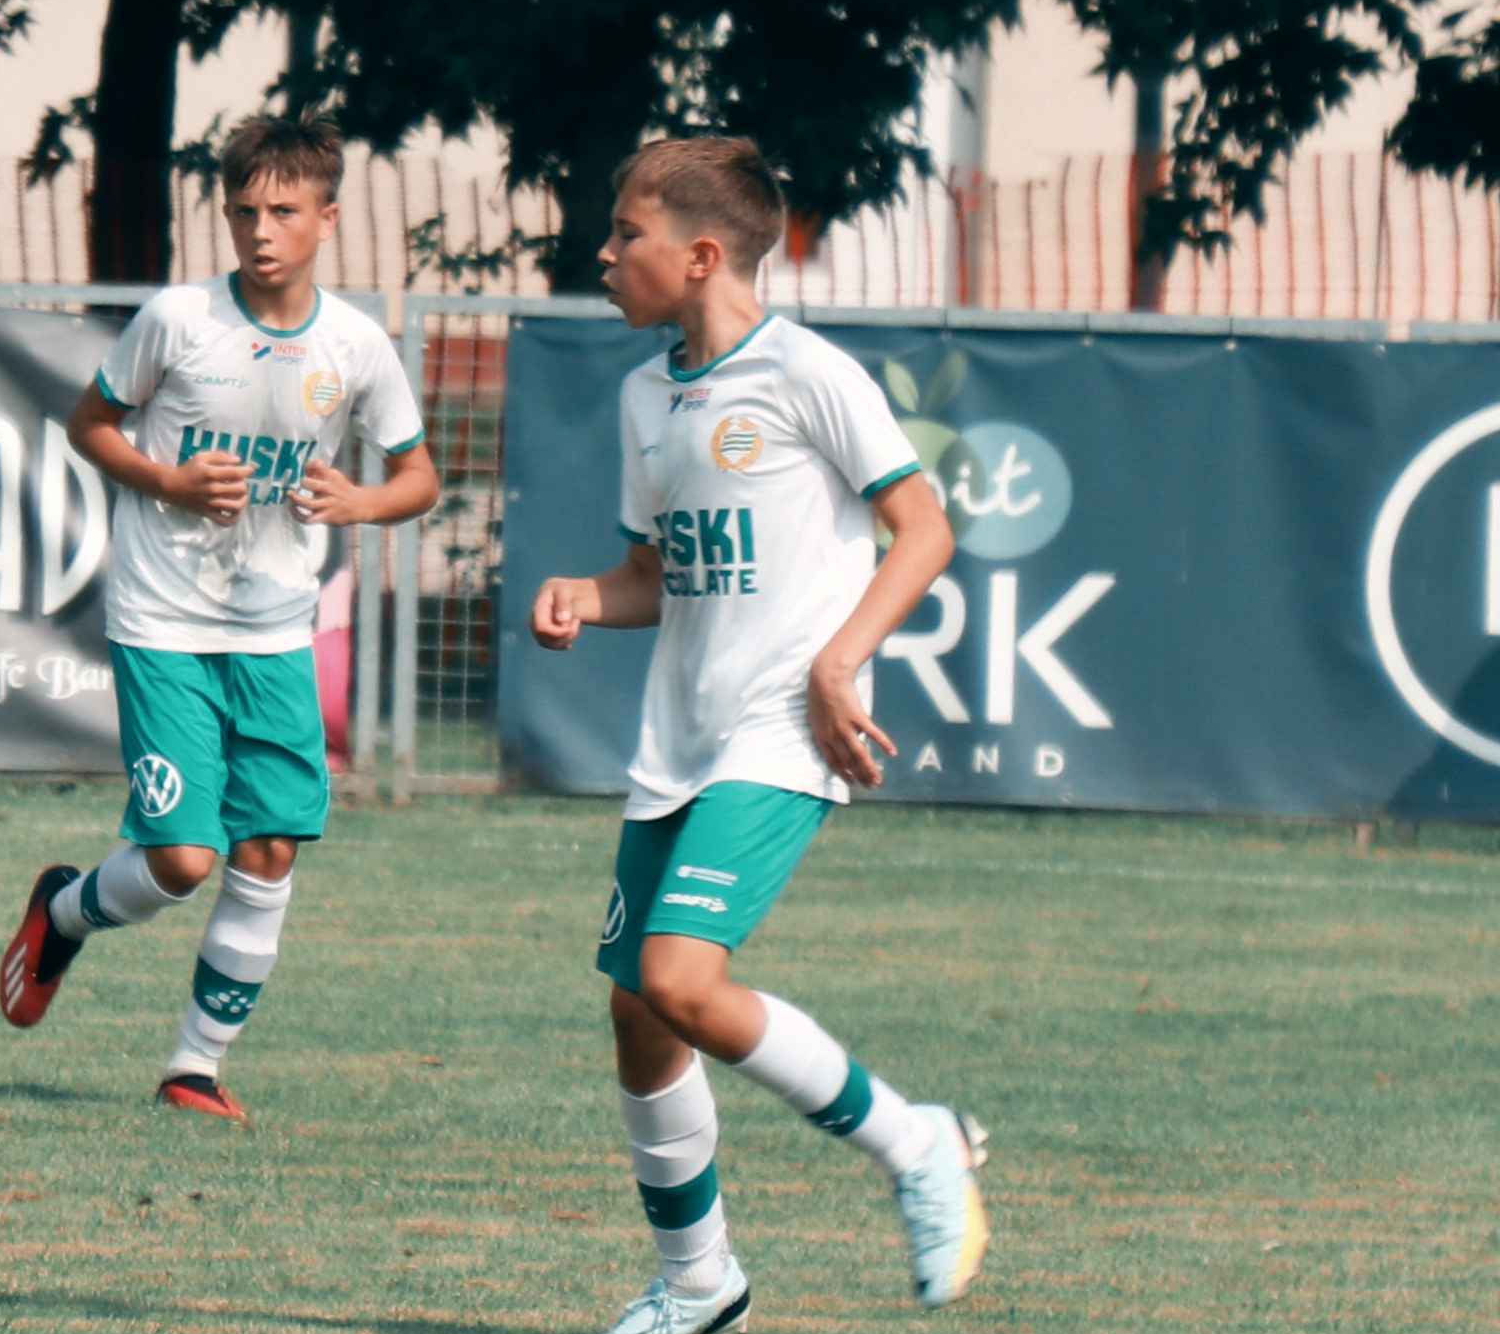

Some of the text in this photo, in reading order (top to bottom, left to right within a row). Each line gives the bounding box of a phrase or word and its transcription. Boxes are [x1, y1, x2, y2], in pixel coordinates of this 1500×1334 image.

[881, 570, 1116, 728] RK
[36, 656, 112, 700] Bar
[916, 740, 1065, 778] AND
